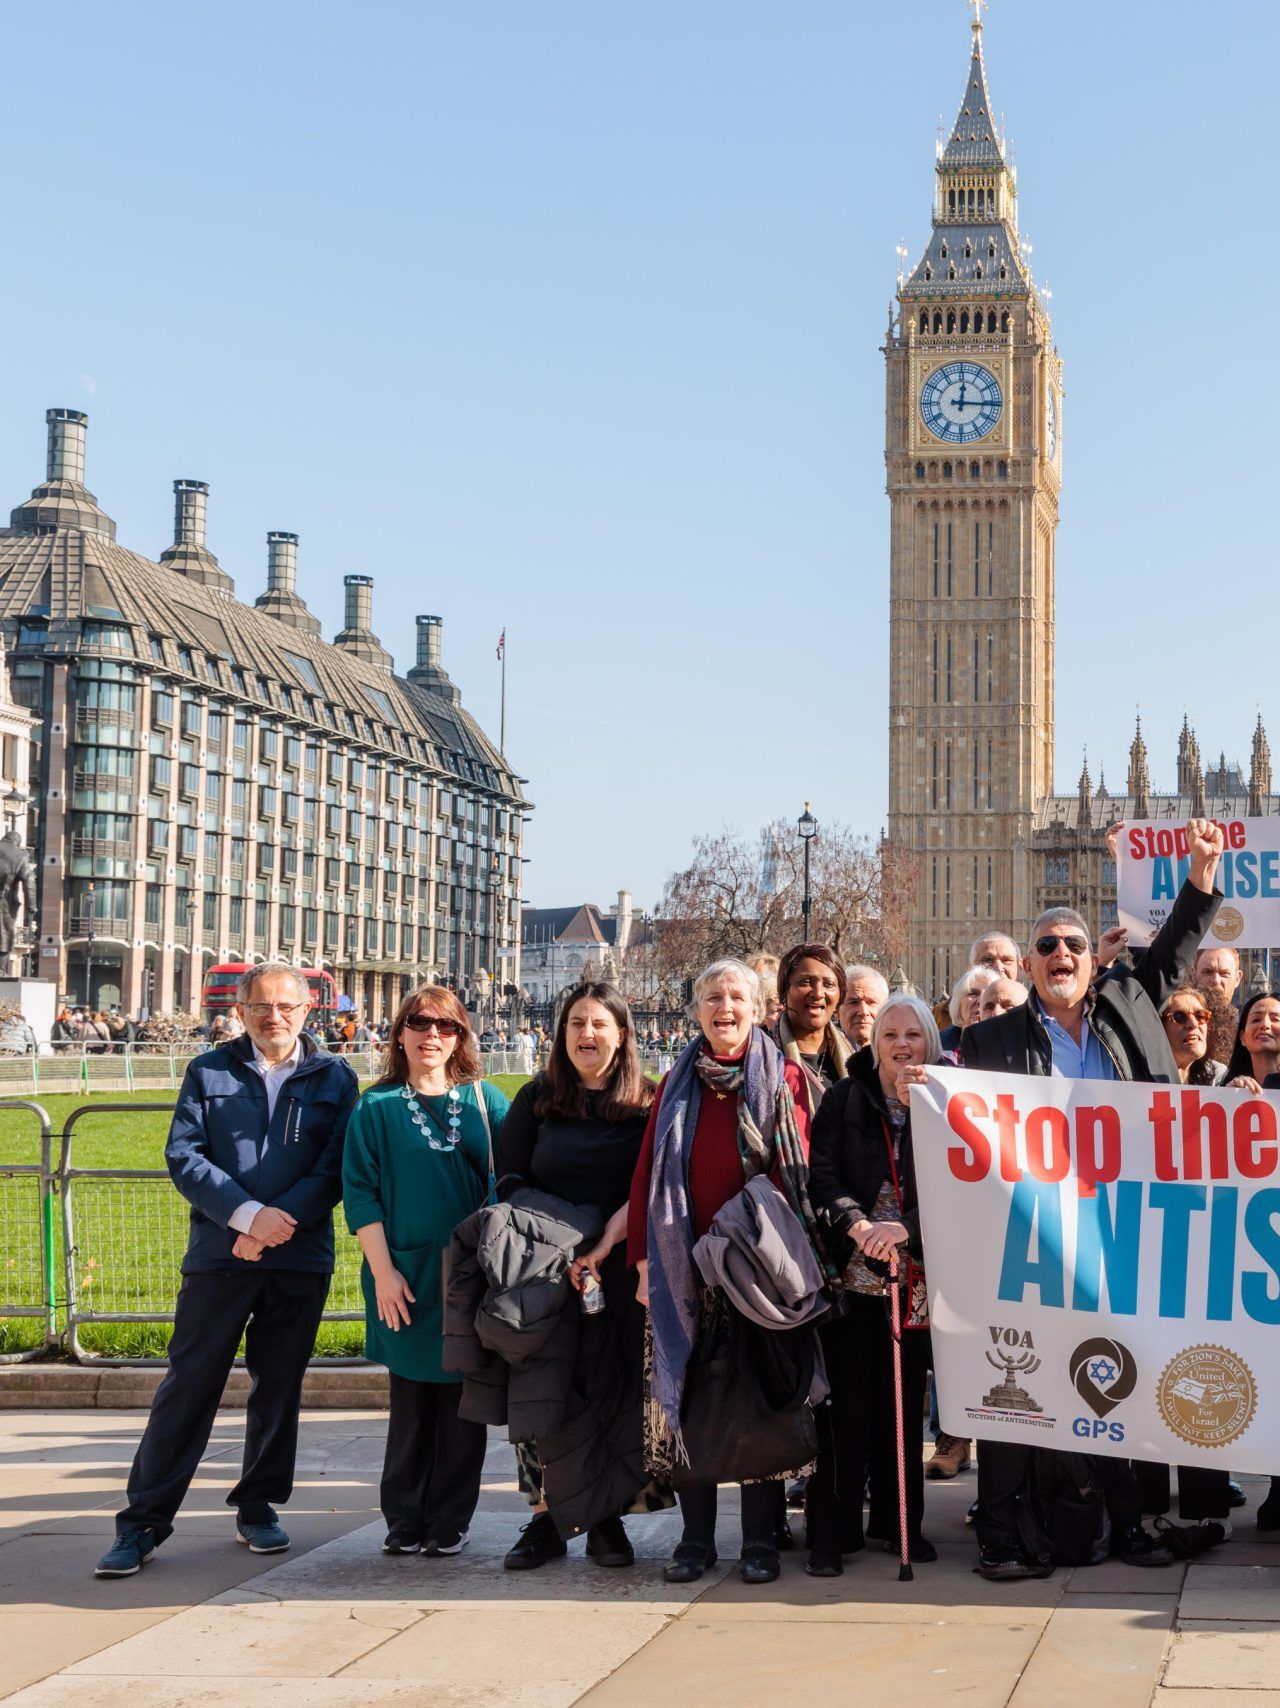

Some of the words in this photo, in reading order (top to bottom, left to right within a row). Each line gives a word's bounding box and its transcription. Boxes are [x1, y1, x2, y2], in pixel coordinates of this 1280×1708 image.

[1128, 826, 1191, 861] Stop
[1210, 818, 1246, 850] he
[1149, 909, 1166, 917] VOA
[947, 1091, 1122, 1198] Stop
[1148, 1089, 1278, 1182] the
[989, 1326, 1035, 1349] VOA
[1172, 1359, 1189, 1376] FOR
[1190, 1352, 1221, 1363] ZION'S
[1222, 1358, 1243, 1379] SAKE
[1189, 1371, 1225, 1381] United
[967, 1412, 996, 1421] VICTIMS
[1005, 1417, 1054, 1429] ANTISEMITISM
[1165, 1402, 1180, 1426] WILL
[1180, 1424, 1201, 1438] NOT
[1203, 1428, 1226, 1440] KEEP
[1227, 1399, 1247, 1432] SILENT
[1191, 1416, 1219, 1426] Israel
[1199, 1408, 1213, 1416] For
[1072, 1417, 1125, 1442] GPS
